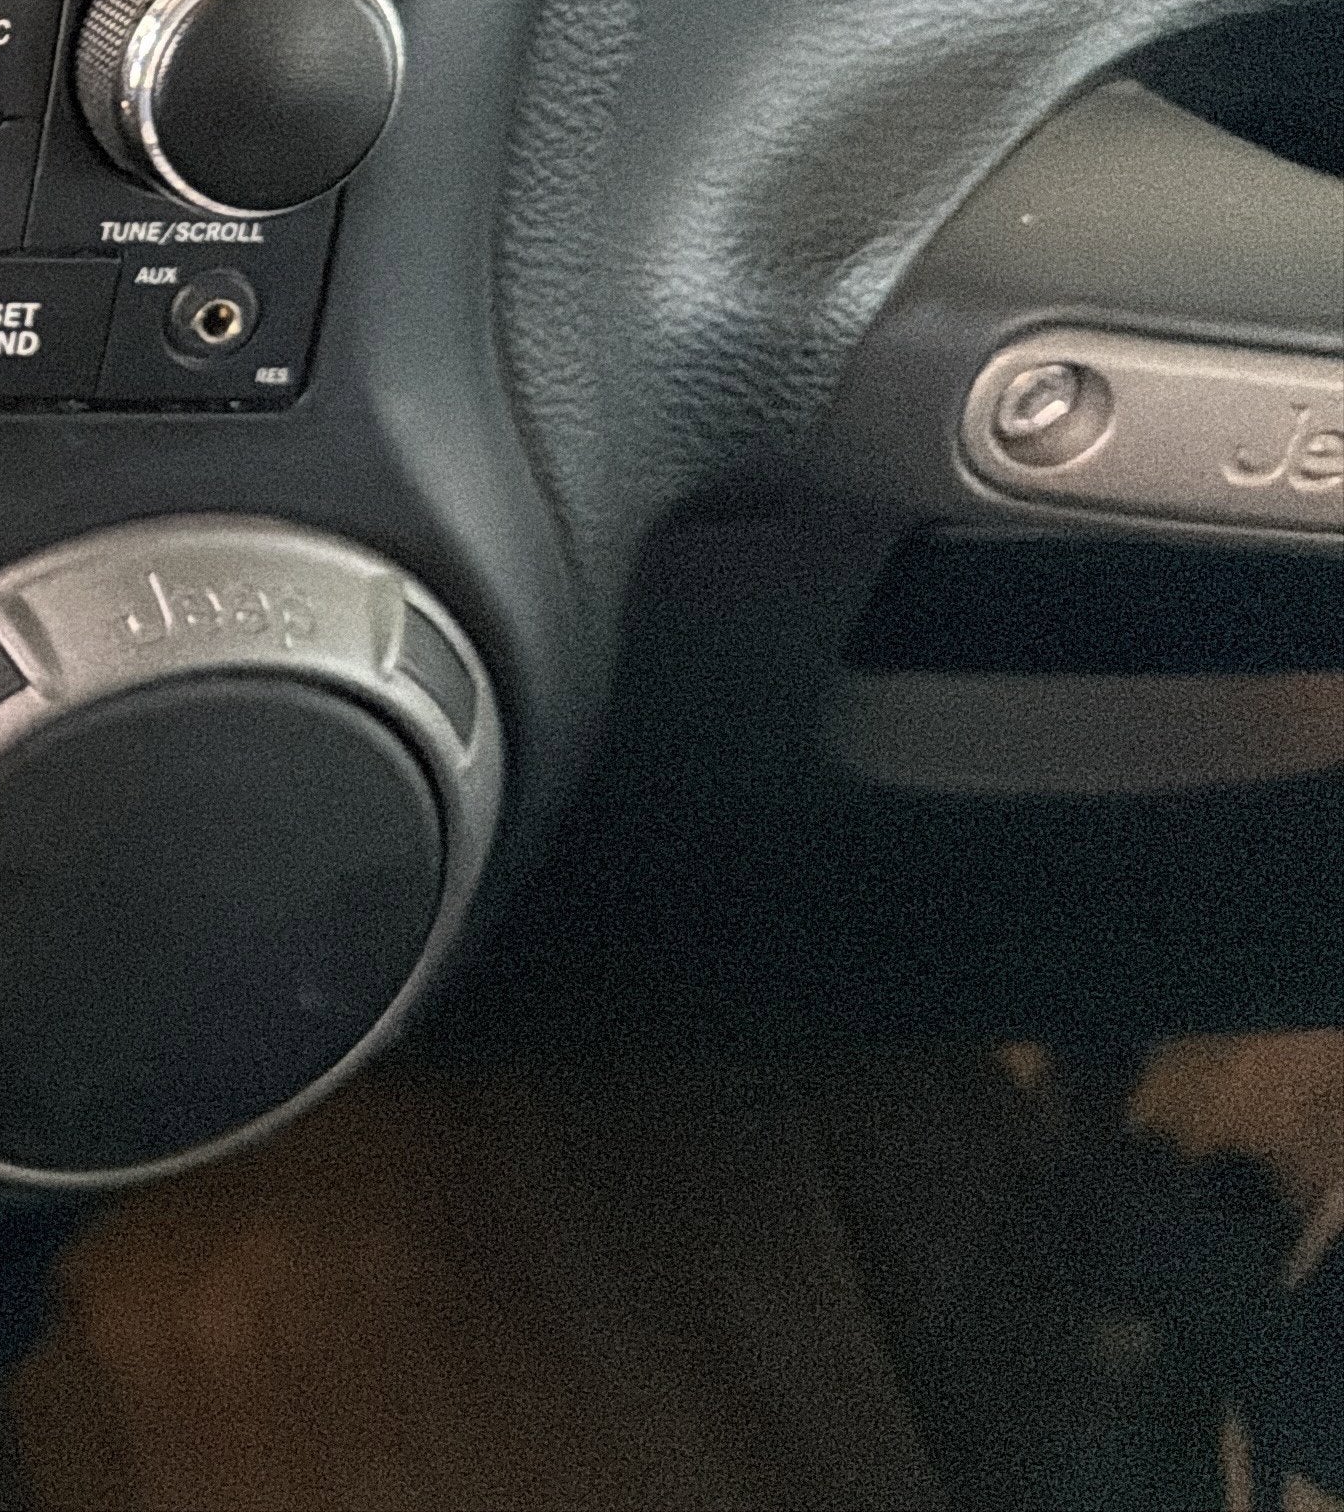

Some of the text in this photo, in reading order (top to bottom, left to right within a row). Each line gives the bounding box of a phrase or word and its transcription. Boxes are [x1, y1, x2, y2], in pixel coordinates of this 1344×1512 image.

[99, 220, 265, 245] TUNE/SCROLL
[134, 265, 179, 286] AUX
[119, 571, 318, 651] Jeep
